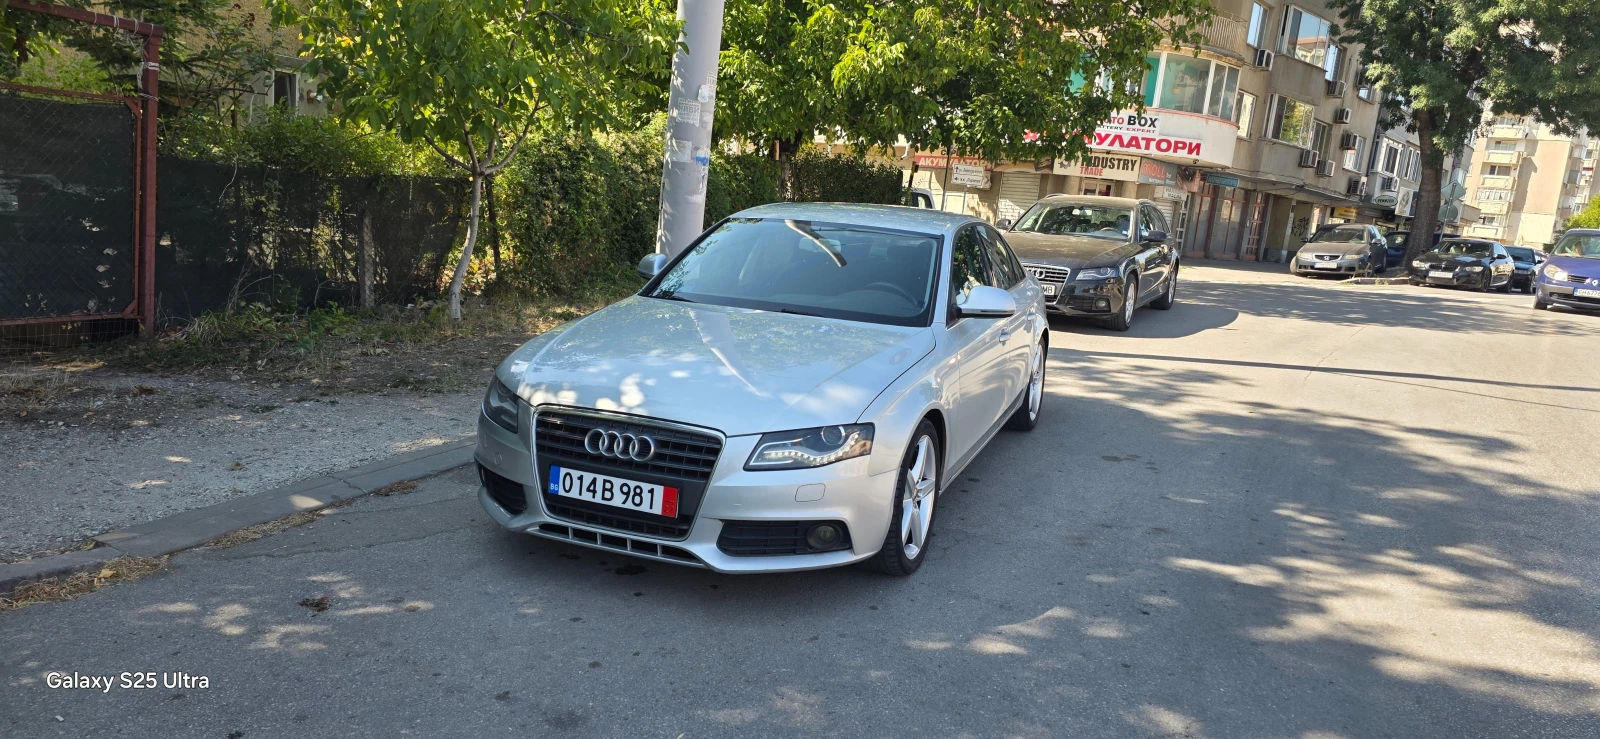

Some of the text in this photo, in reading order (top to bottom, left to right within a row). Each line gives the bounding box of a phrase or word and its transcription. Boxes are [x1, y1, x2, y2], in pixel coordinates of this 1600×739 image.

[1127, 115, 1158, 129] BOX
[1080, 166, 1104, 177] TRADE
[550, 482, 559, 491] BG
